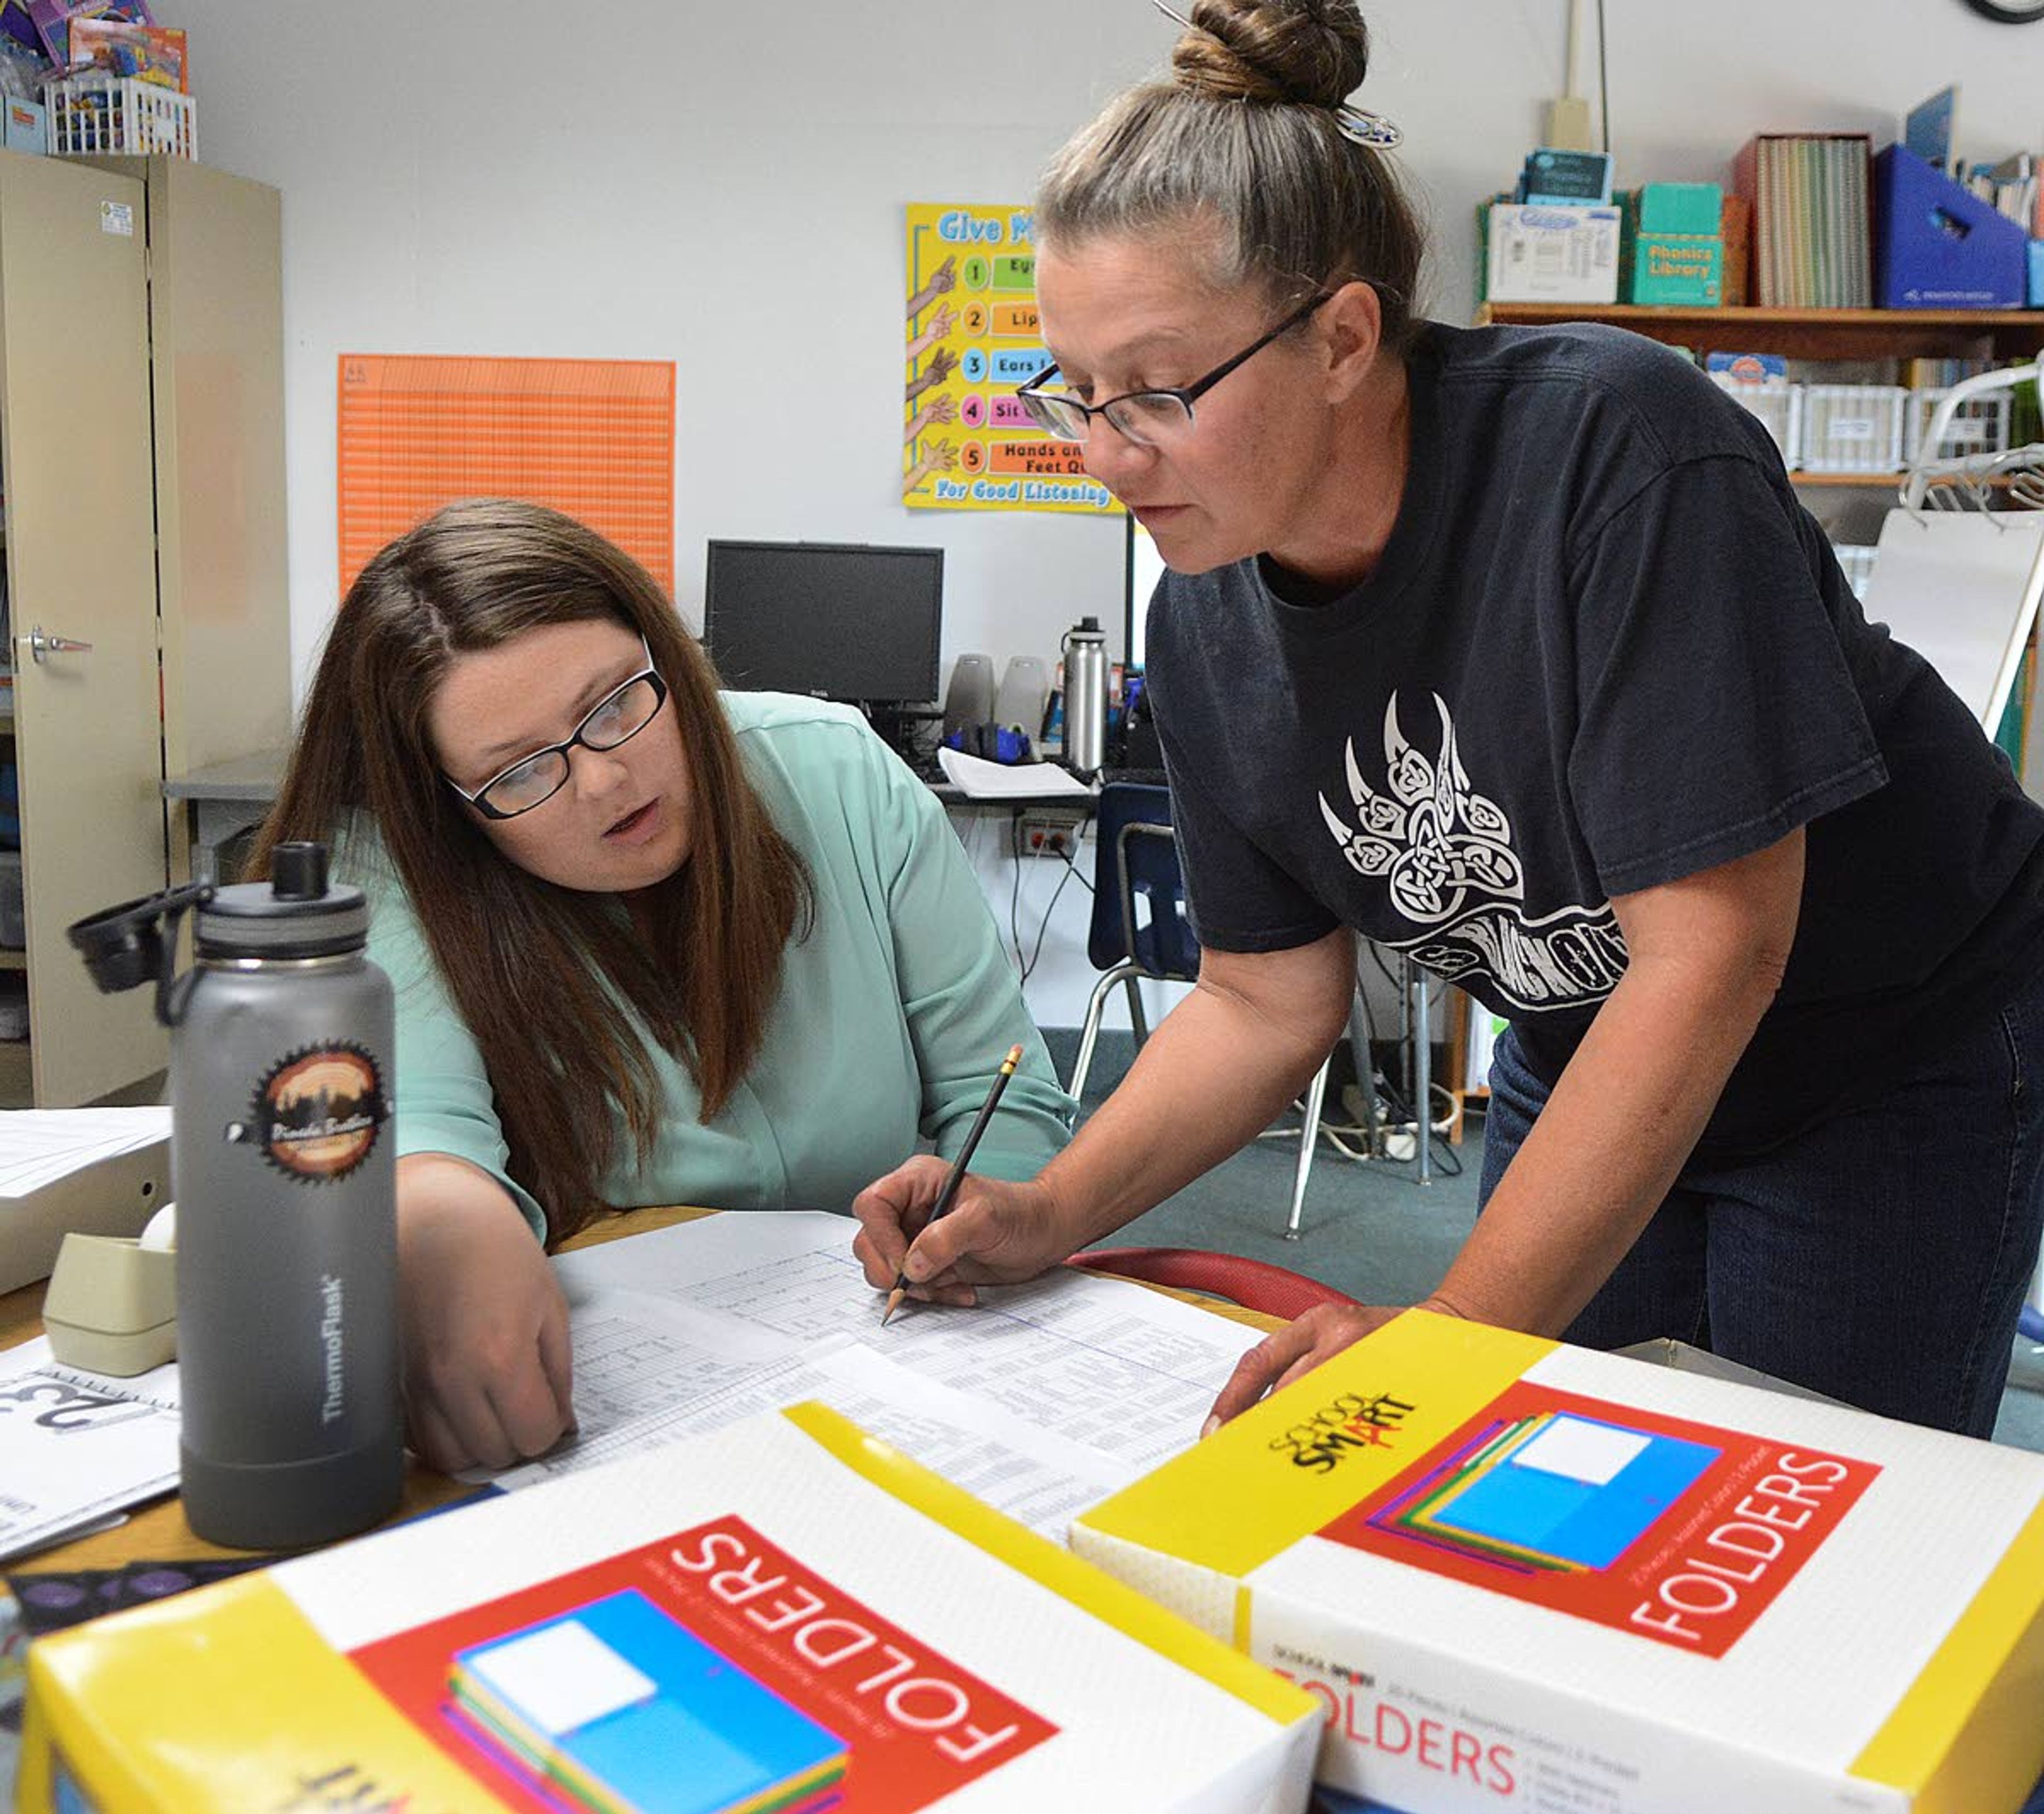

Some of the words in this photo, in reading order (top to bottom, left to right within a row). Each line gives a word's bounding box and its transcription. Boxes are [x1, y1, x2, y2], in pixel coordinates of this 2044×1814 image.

[939, 212, 1002, 243] Give
[1649, 246, 1712, 261] Phonics
[972, 266, 978, 280] 1
[1649, 263, 1709, 279] Library
[971, 312, 980, 326] 2
[970, 358, 979, 373] 3
[1000, 359, 1033, 371] Ears
[967, 403, 977, 417] 4
[996, 403, 1018, 417] Sit
[969, 450, 978, 465] 5
[1005, 444, 1055, 456] Hands
[1027, 460, 1061, 473] Feet
[936, 480, 965, 498] For
[974, 480, 1019, 500] Good
[1025, 481, 1110, 506] Listening
[1269, 1392, 1378, 1456] SCHOOL
[1292, 1392, 1415, 1474] SMART
[1630, 1452, 1848, 1640] FOLDERS
[671, 1533, 1019, 1762] FOLDERS
[1273, 1667, 1516, 1796] OLDERS
